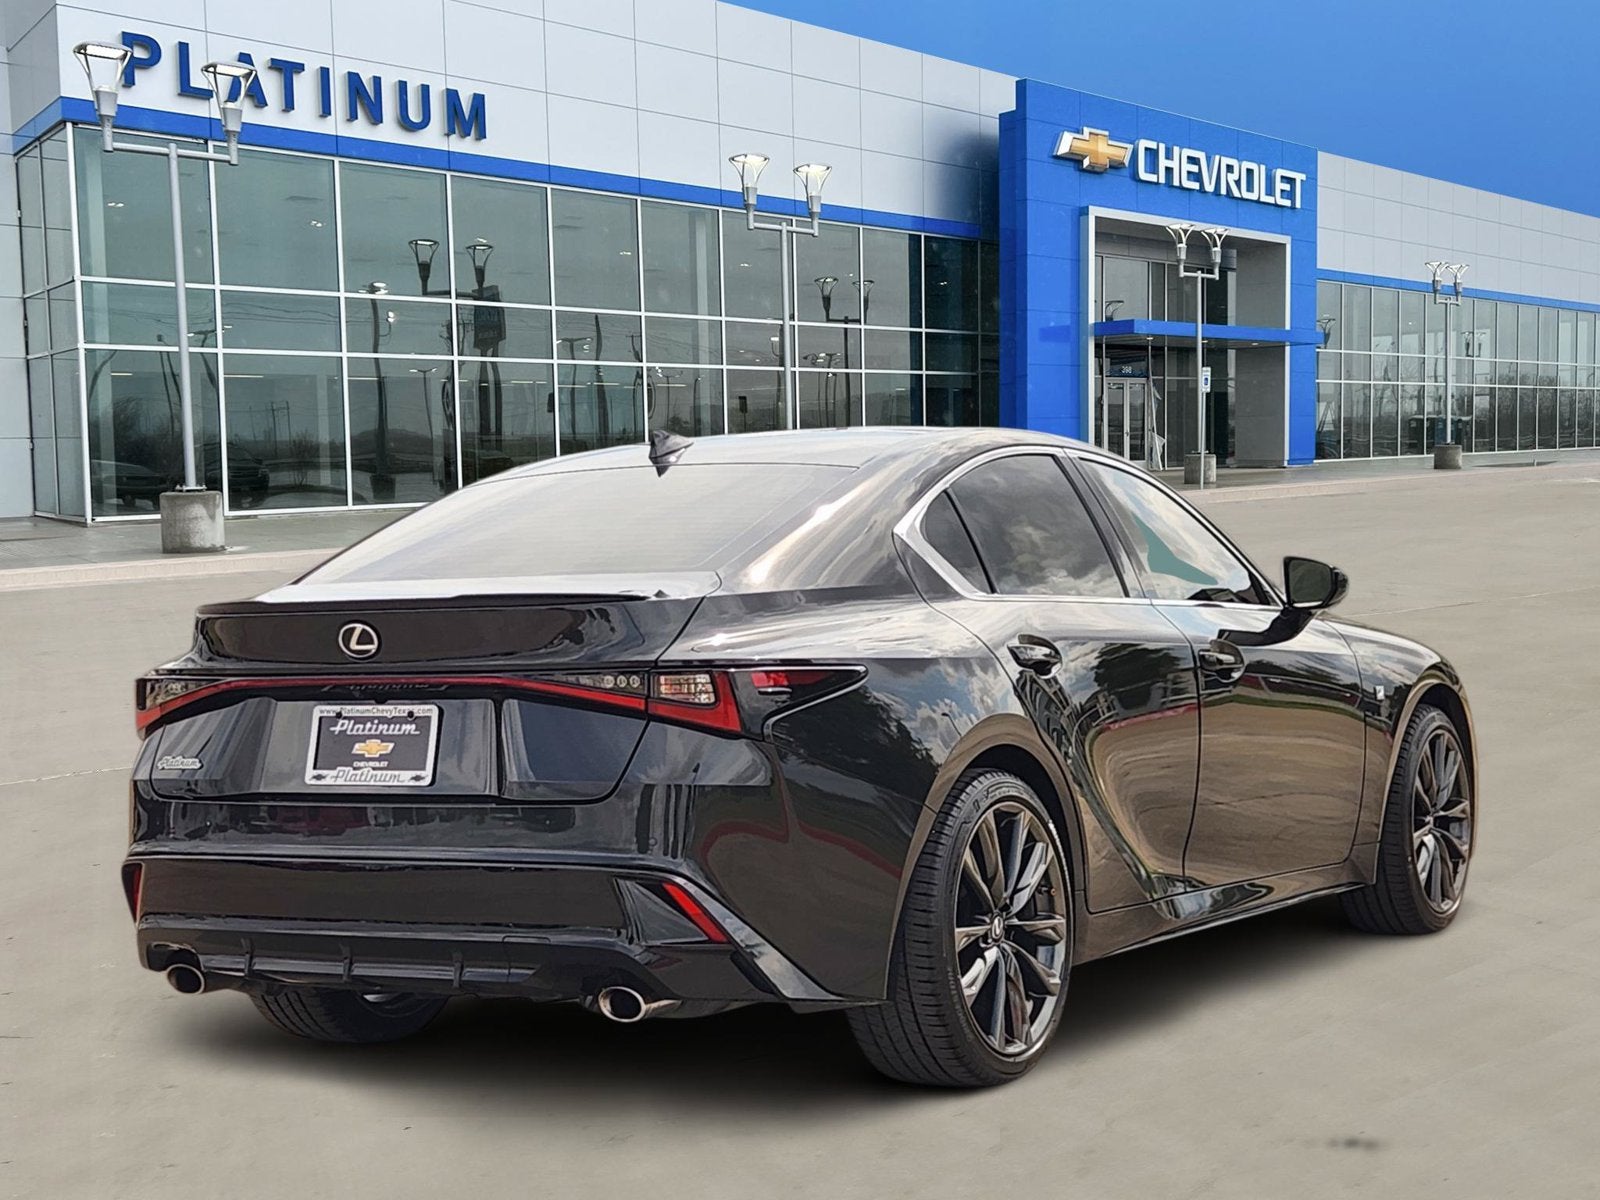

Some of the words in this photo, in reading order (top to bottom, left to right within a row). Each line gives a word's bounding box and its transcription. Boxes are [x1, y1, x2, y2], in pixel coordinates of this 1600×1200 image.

[119, 31, 487, 141] PLATINUM
[1136, 139, 1306, 209] CHEVROLET
[319, 706, 433, 717] wwwPlatinumChevyTex.com
[329, 719, 420, 735] Platinum
[330, 767, 406, 783] Platinum
